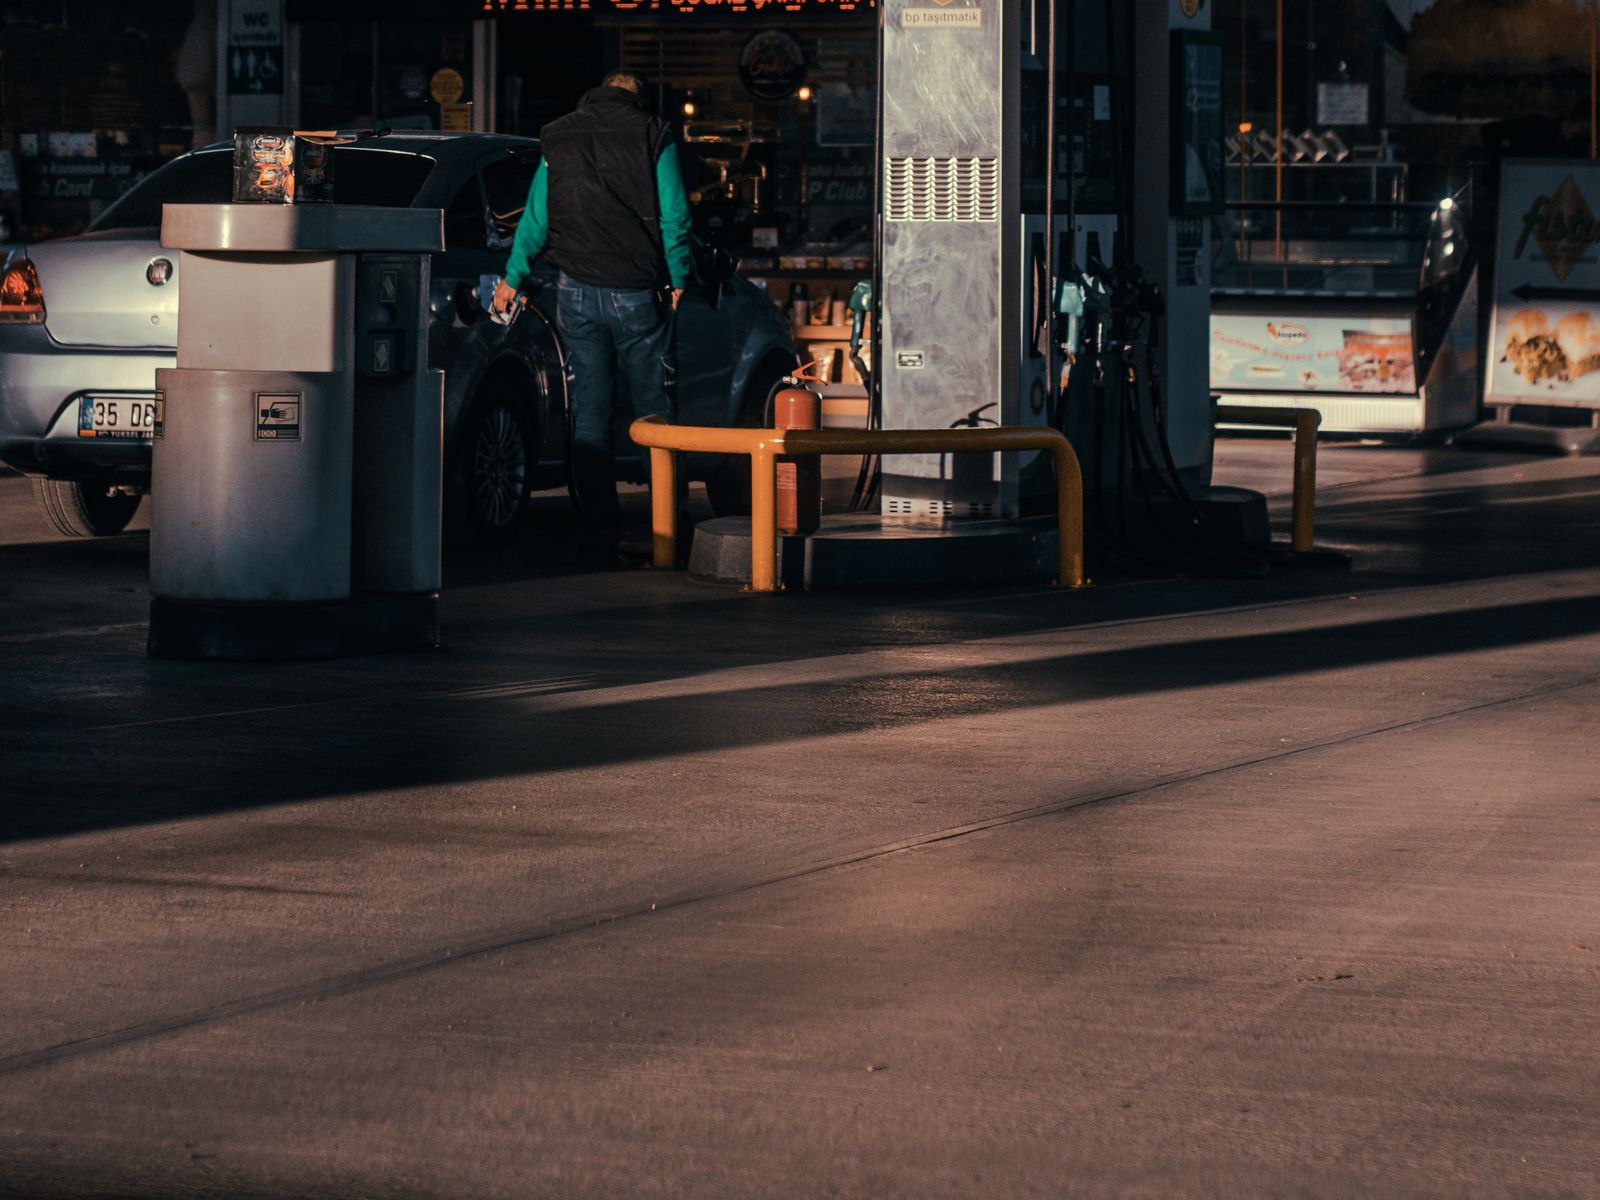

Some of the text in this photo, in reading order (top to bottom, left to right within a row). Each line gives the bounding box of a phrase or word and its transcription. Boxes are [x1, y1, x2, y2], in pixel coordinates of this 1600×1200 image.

[243, 12, 268, 27] WC
[904, 11, 978, 24] bp taşıtmatik
[54, 177, 95, 197] Card
[824, 180, 867, 201] Club
[95, 402, 117, 426] 35
